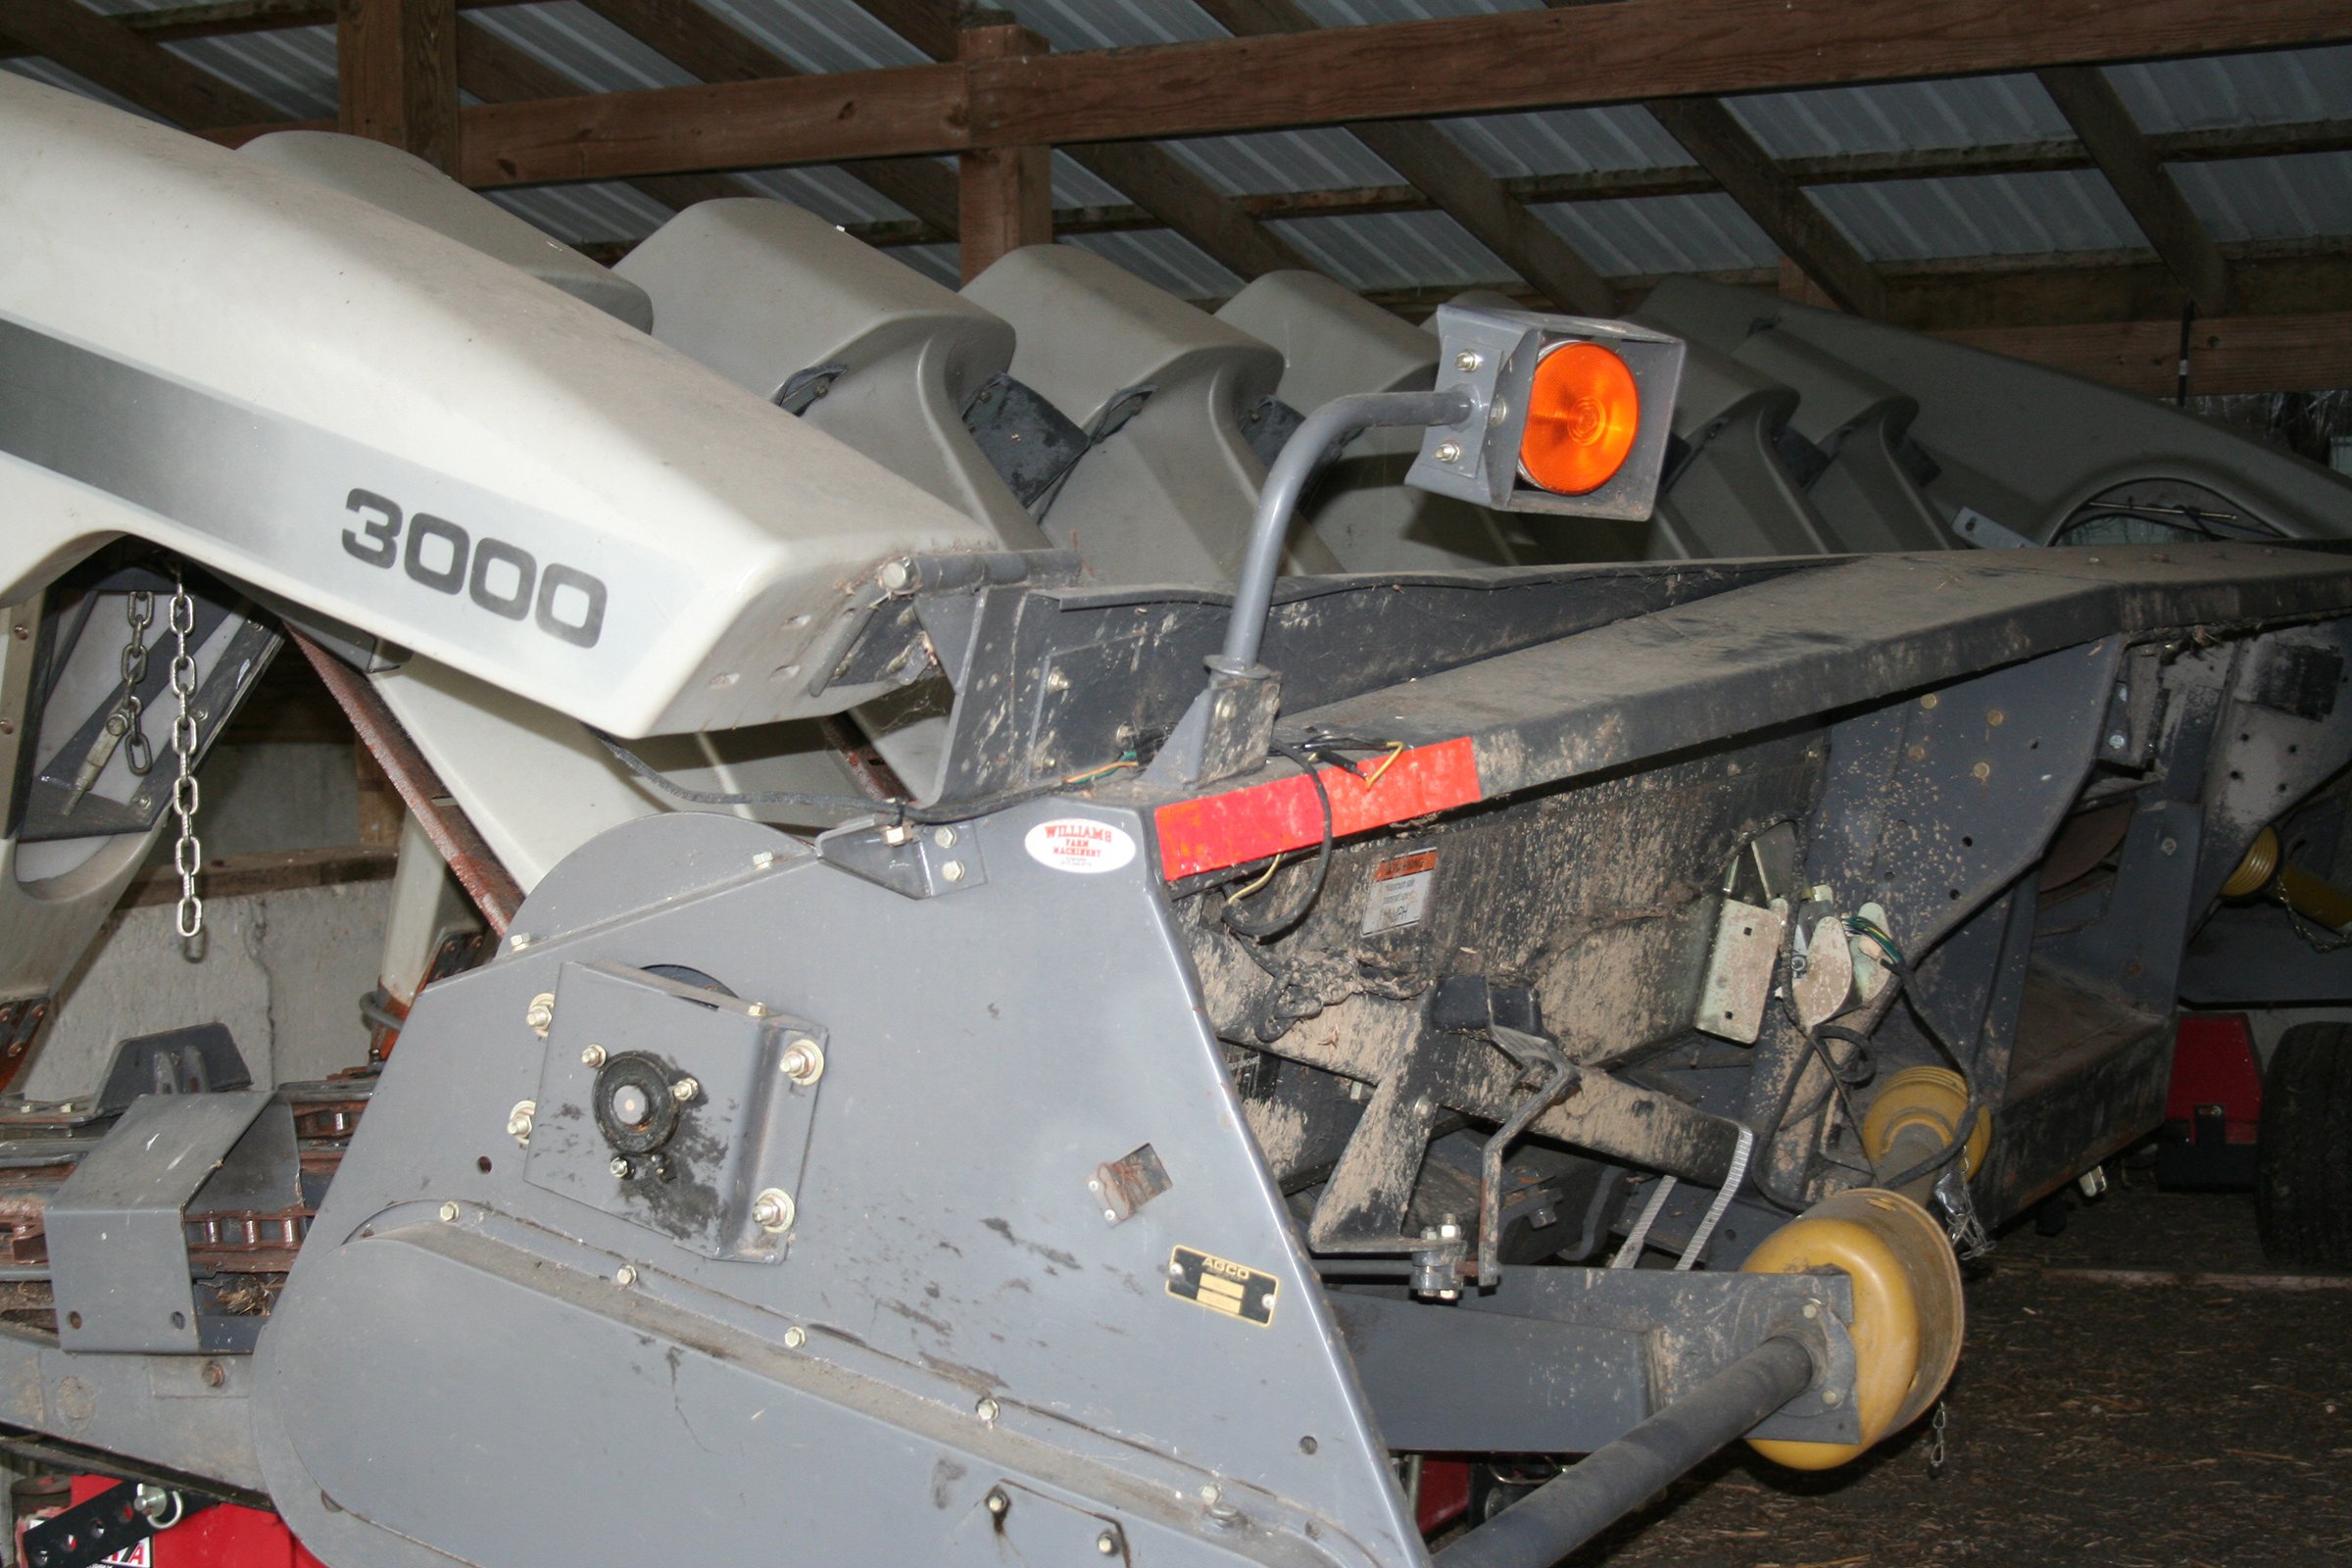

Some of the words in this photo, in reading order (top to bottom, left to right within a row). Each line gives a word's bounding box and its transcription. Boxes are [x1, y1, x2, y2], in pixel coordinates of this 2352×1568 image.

[342, 487, 608, 649] 3000
[1045, 825, 1112, 843] WILLIAMS
[1054, 847, 1102, 857] MACHINERY
[1201, 1257, 1250, 1280] AGCO
